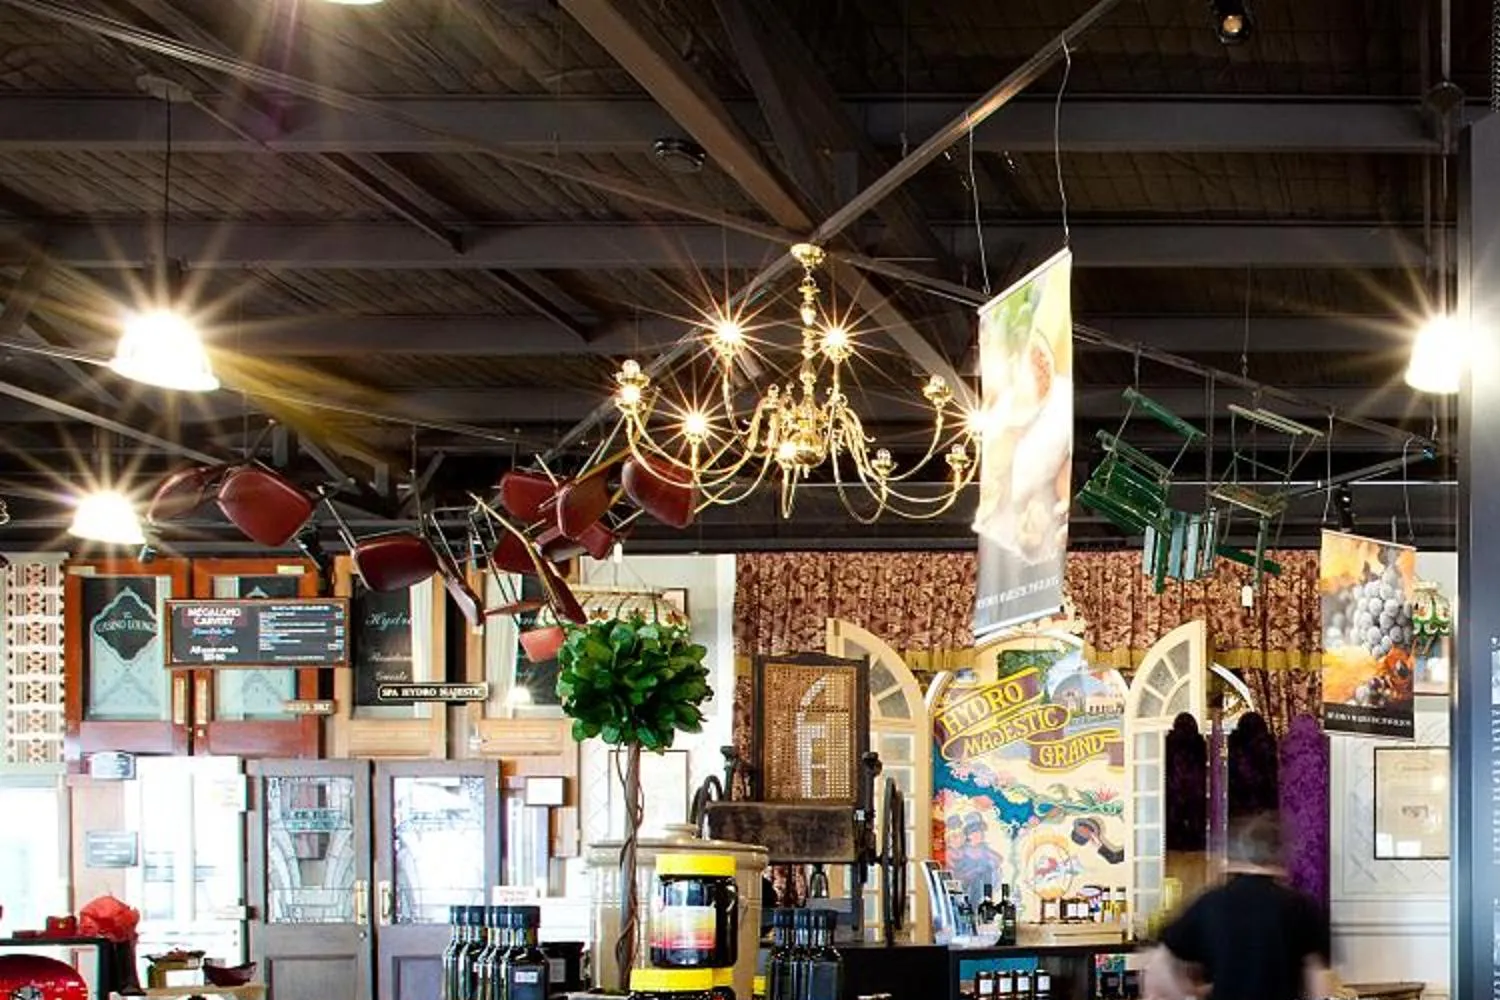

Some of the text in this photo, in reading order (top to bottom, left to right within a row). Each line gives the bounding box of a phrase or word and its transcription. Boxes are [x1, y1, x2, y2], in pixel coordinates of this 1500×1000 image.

[382, 687, 482, 698] SPA HYDRO MAJESTIC
[940, 681, 1023, 736] HYDRO
[963, 706, 1058, 757] MAJESTIC
[1039, 734, 1105, 766] GRAND
